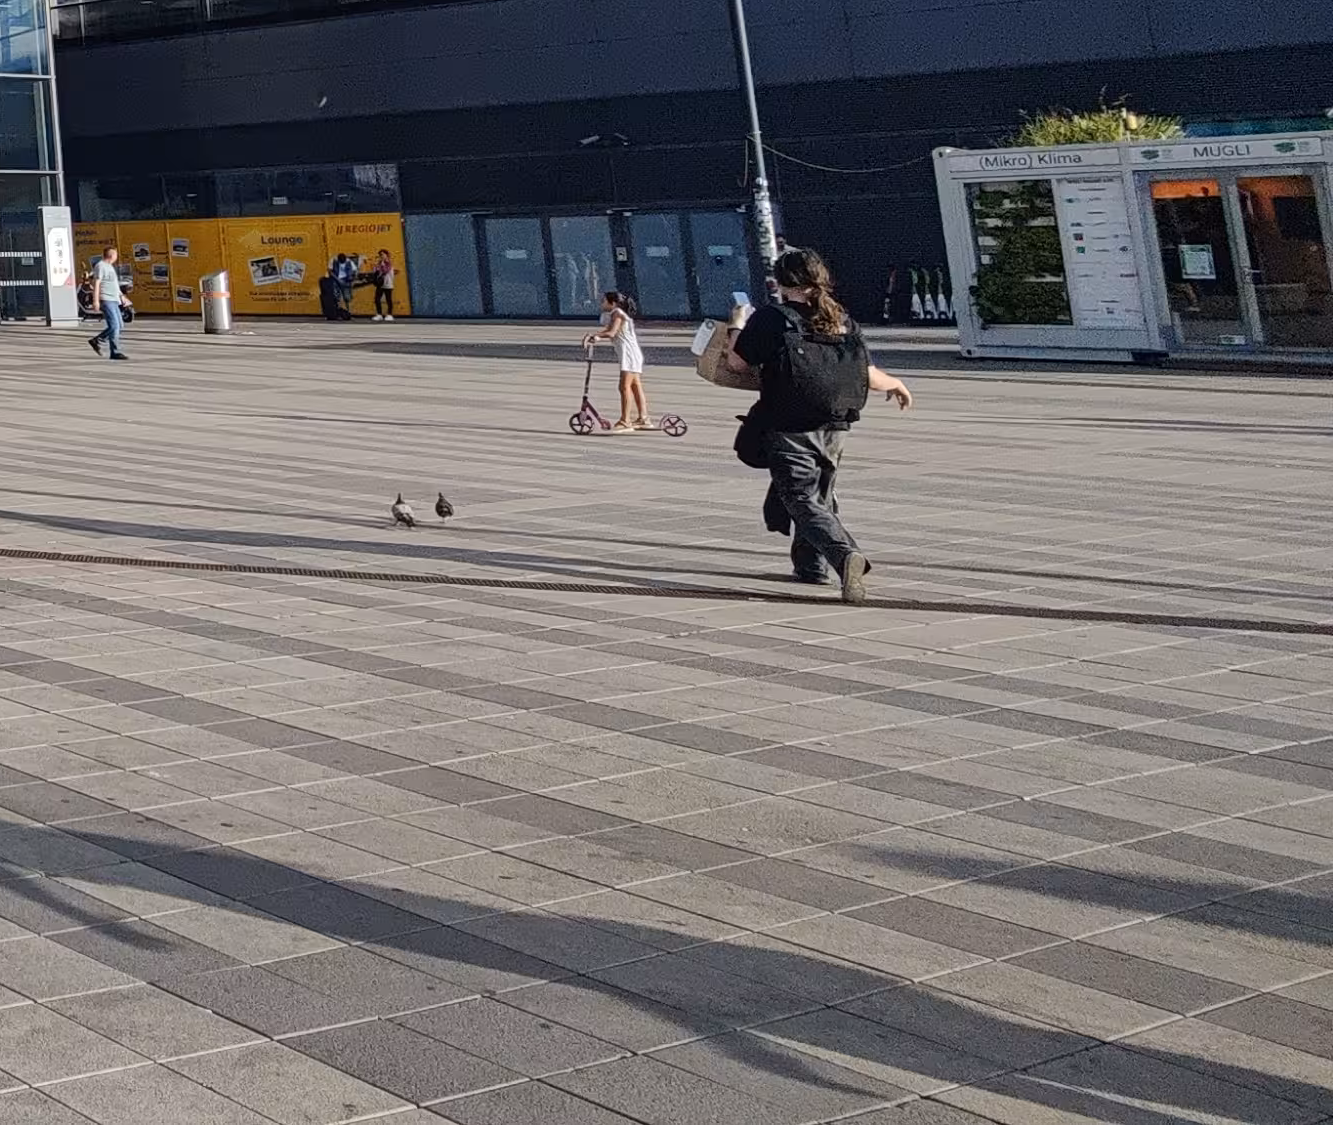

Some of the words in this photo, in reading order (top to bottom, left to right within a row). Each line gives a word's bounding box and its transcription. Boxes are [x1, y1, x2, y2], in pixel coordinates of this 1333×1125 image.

[1193, 144, 1251, 158] MUGLI
[978, 153, 1033, 171] (Mikro)
[1037, 152, 1082, 166] Klima
[261, 235, 304, 246] Lounge
